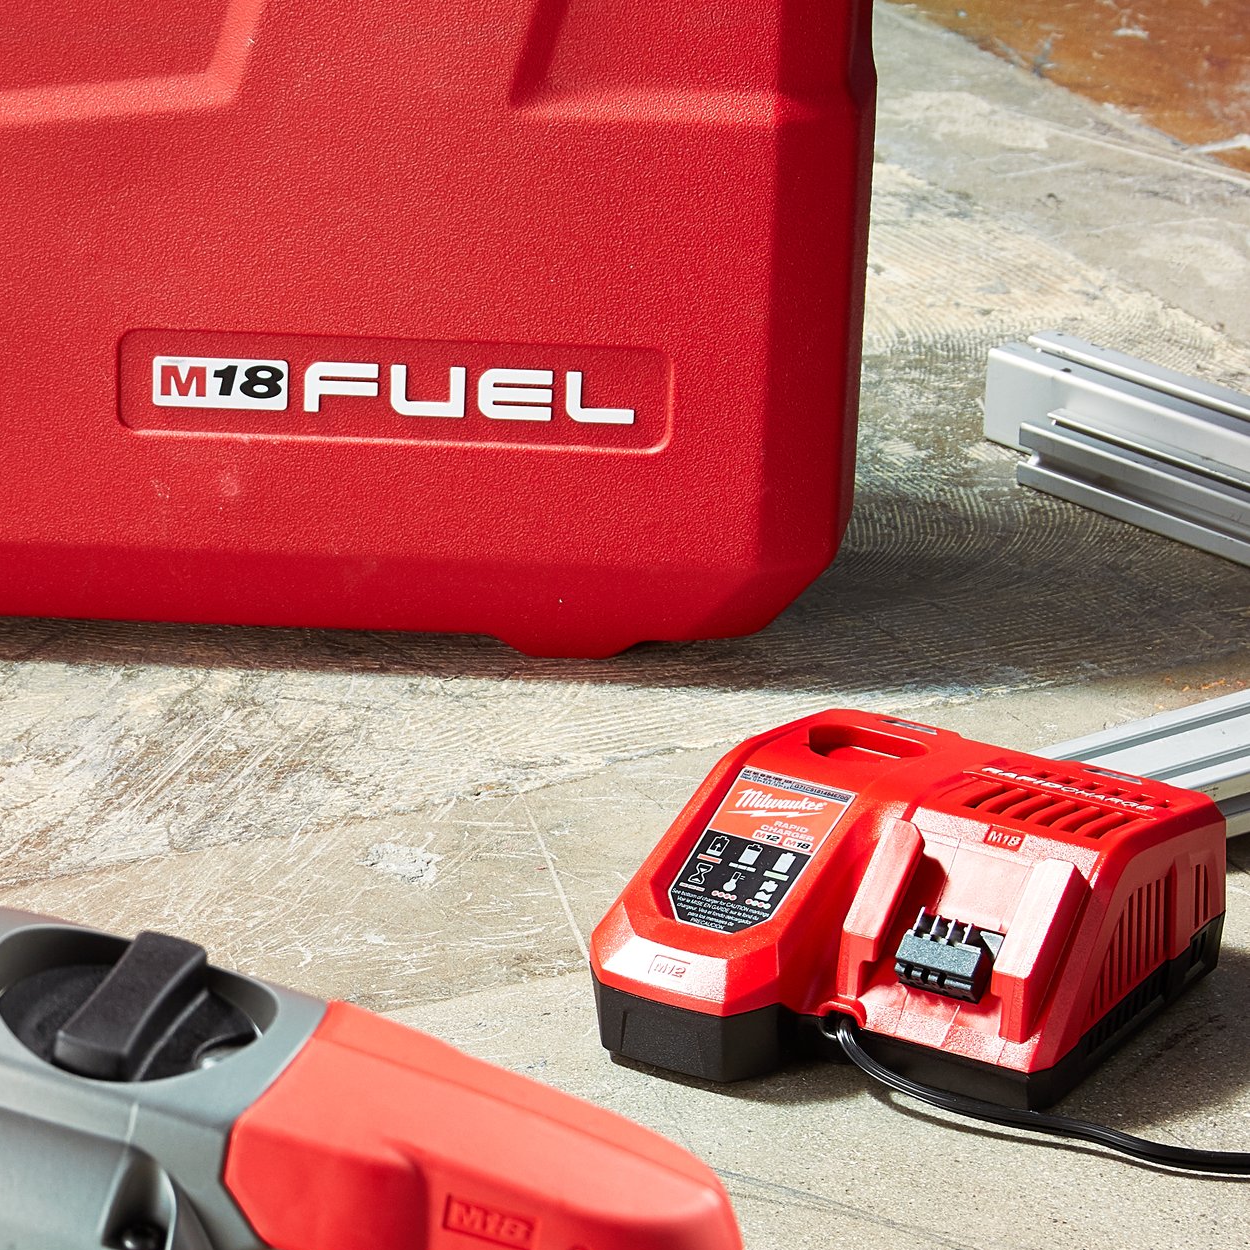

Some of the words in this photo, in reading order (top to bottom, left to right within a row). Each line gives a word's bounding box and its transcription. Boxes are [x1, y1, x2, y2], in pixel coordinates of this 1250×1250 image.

[160, 363, 284, 399] M18
[304, 361, 635, 424] FUEL
[735, 789, 824, 811] Milwaukee
[761, 825, 814, 841] CHARGER
[773, 820, 809, 833] RAPID
[754, 831, 780, 843] M12
[785, 838, 811, 850] M18
[987, 829, 1022, 847] M18
[726, 902, 749, 912] CAUTION
[653, 963, 687, 978] M12
[450, 1202, 533, 1241] M18
